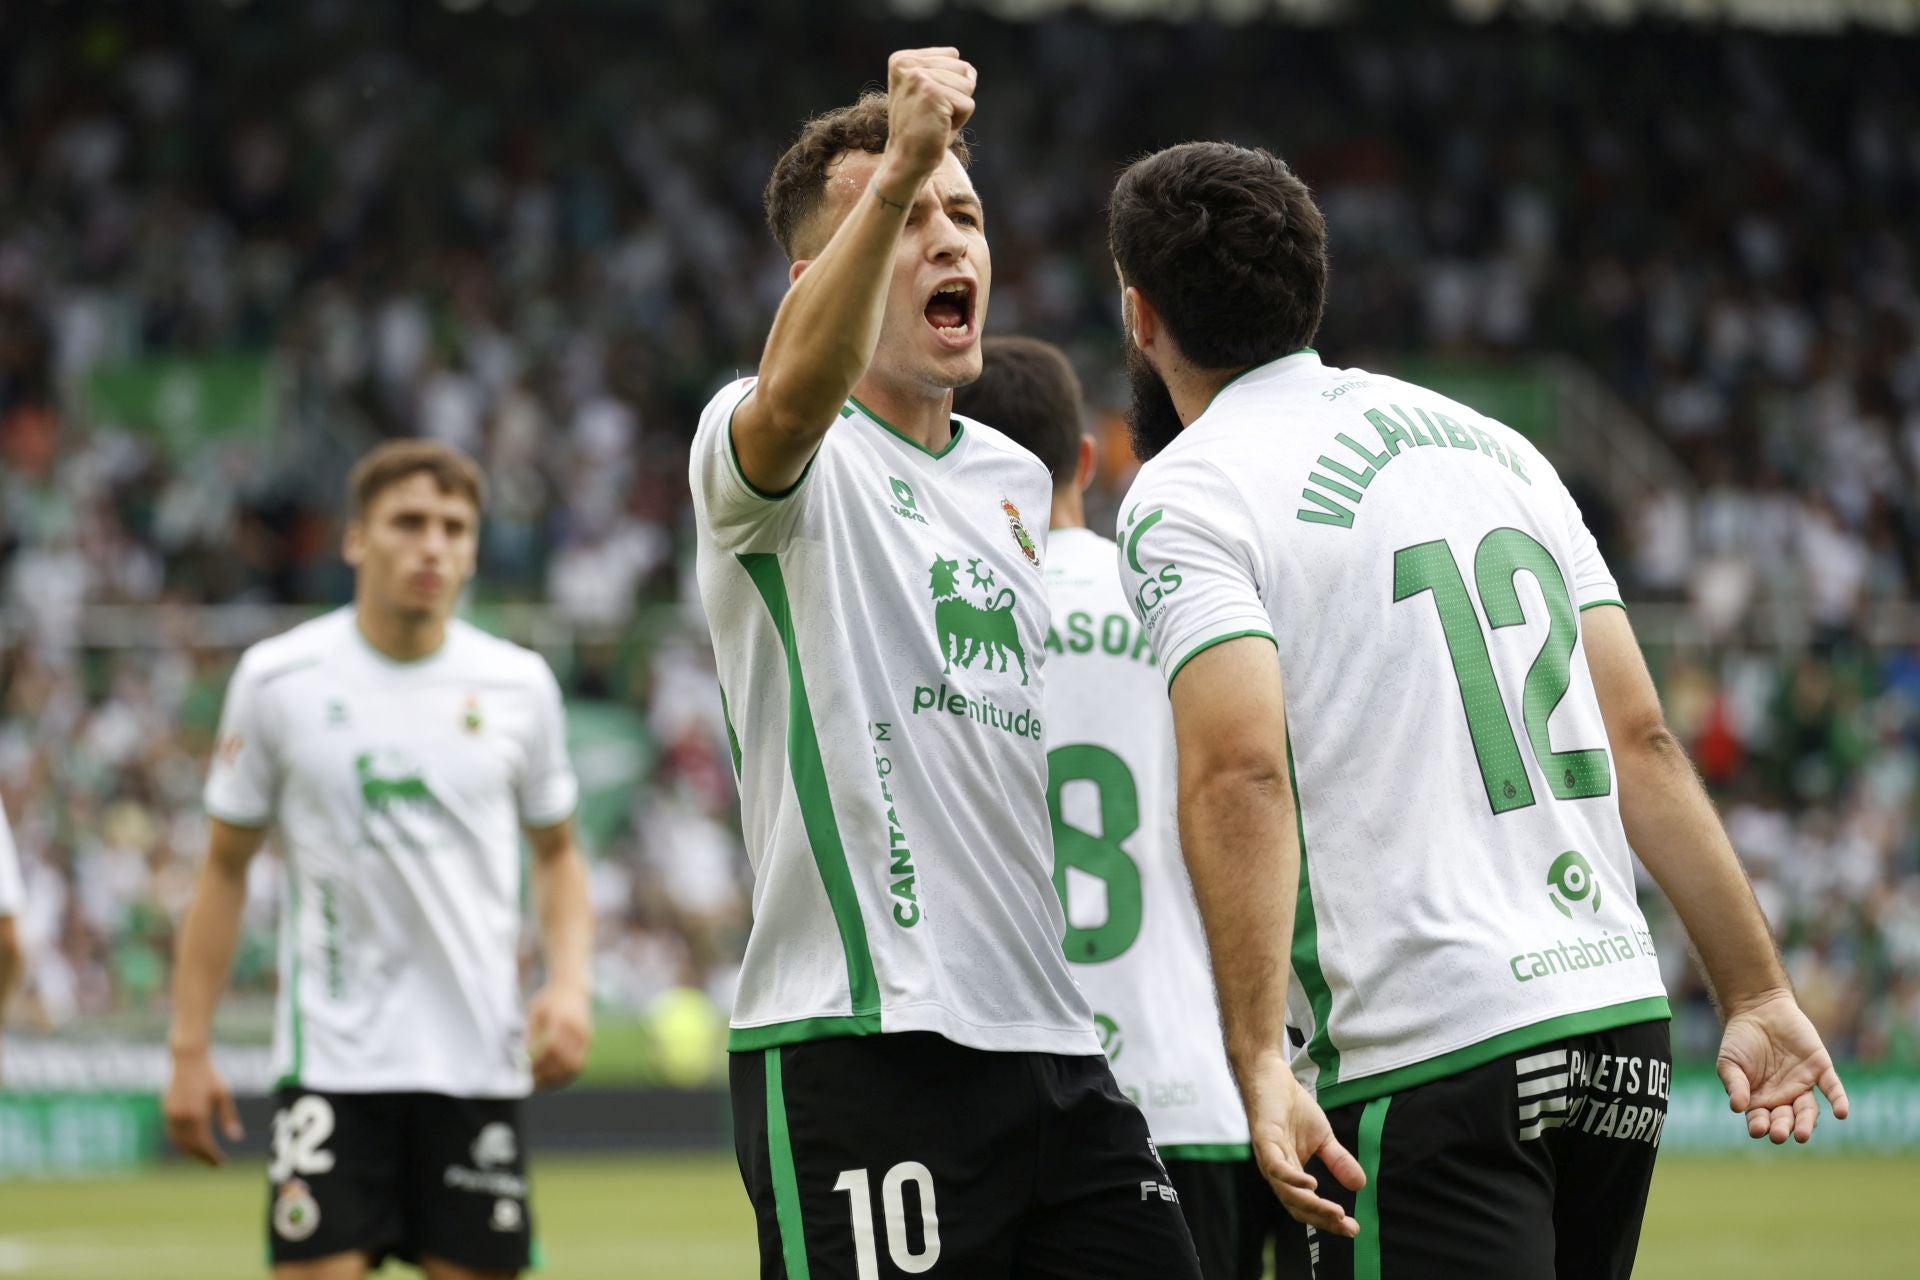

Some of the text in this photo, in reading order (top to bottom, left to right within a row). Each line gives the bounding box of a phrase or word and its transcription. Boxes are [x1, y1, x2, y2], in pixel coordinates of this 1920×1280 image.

[1296, 403, 1532, 529] VILLALIBRE
[912, 683, 1042, 741] plenitude
[1393, 526, 1611, 815] 12
[1046, 743, 1143, 964] 8
[1509, 930, 1635, 983] cantabria
[831, 1160, 941, 1280] 10
